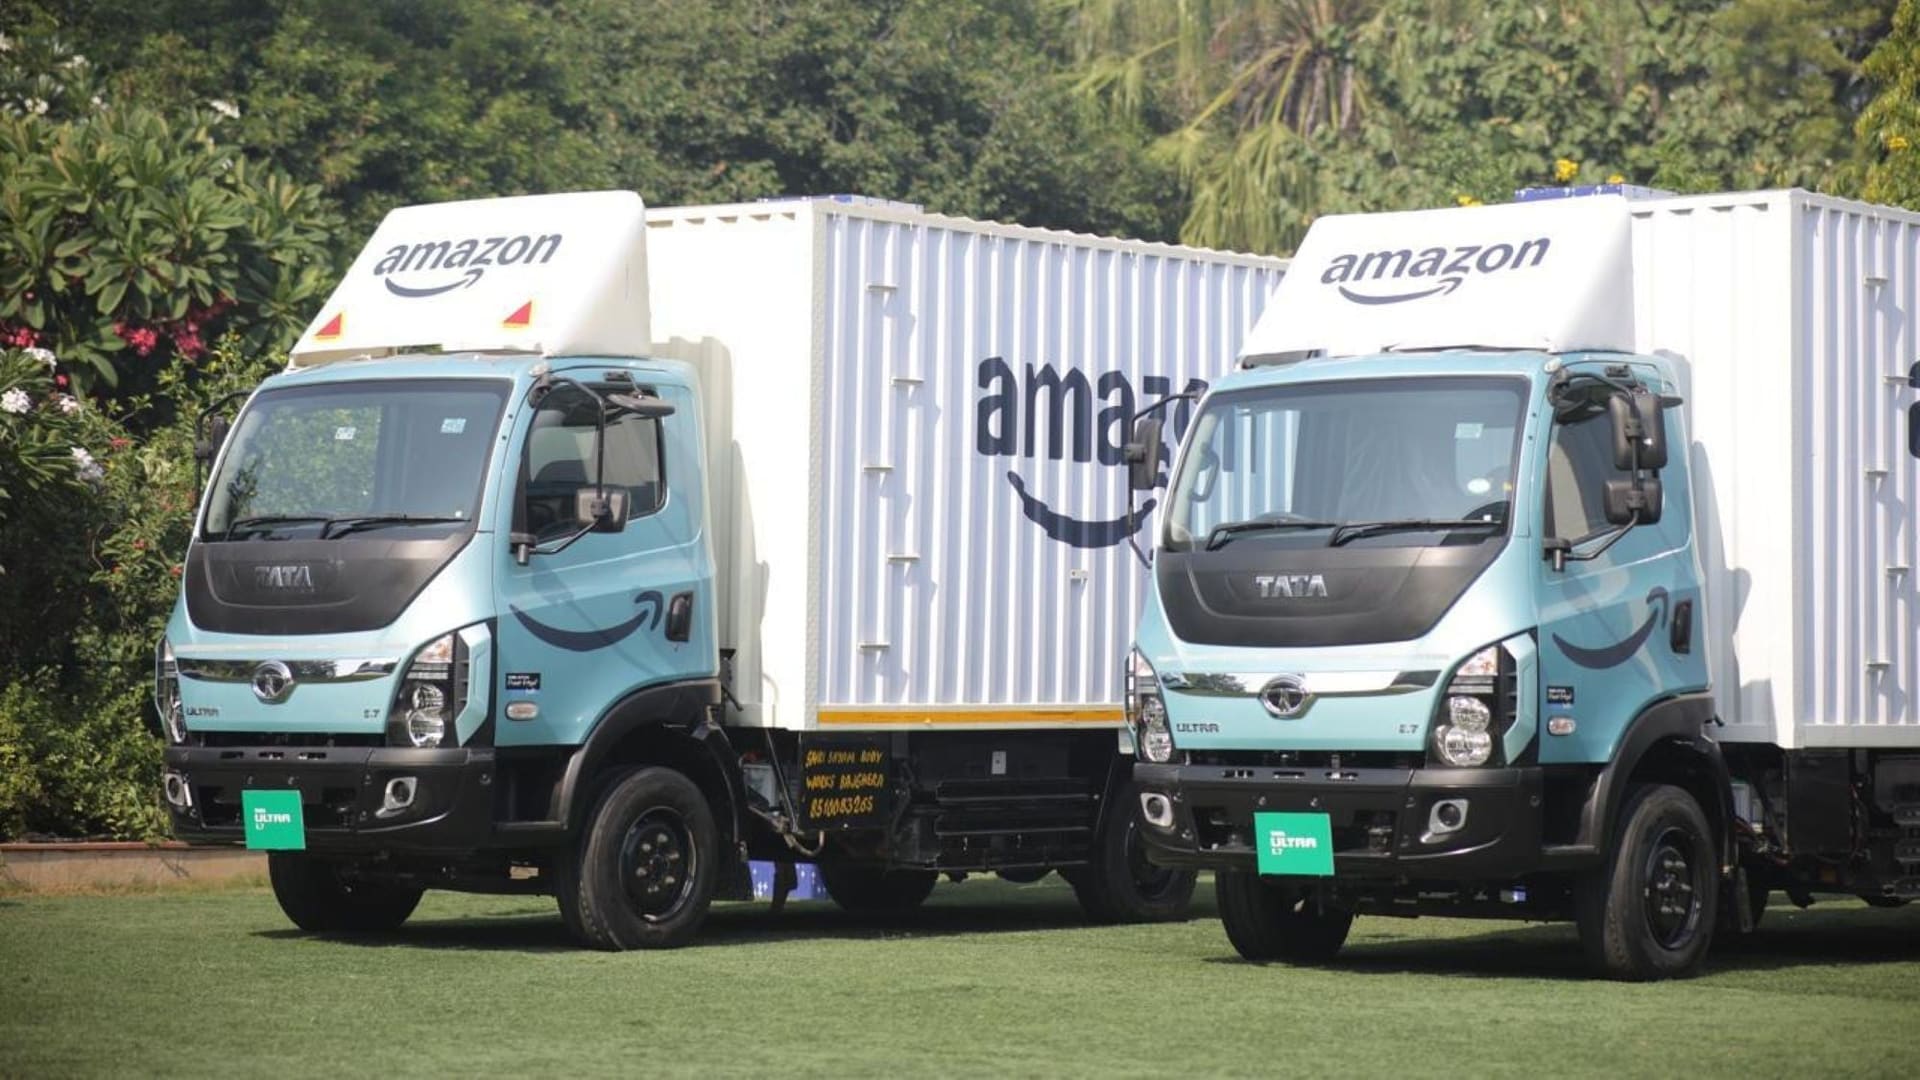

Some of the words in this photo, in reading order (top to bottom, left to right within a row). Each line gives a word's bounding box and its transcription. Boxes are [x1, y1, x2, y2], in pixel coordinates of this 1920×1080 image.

[373, 233, 563, 276] amazon
[1320, 237, 1551, 284] amazon
[253, 565, 313, 588] TATA
[1255, 574, 1328, 598] TATA
[186, 706, 220, 717] ULTRA
[1176, 722, 1220, 734] ULTRA
[254, 813, 291, 823] ULTRA
[1269, 837, 1317, 848] ULTRA
